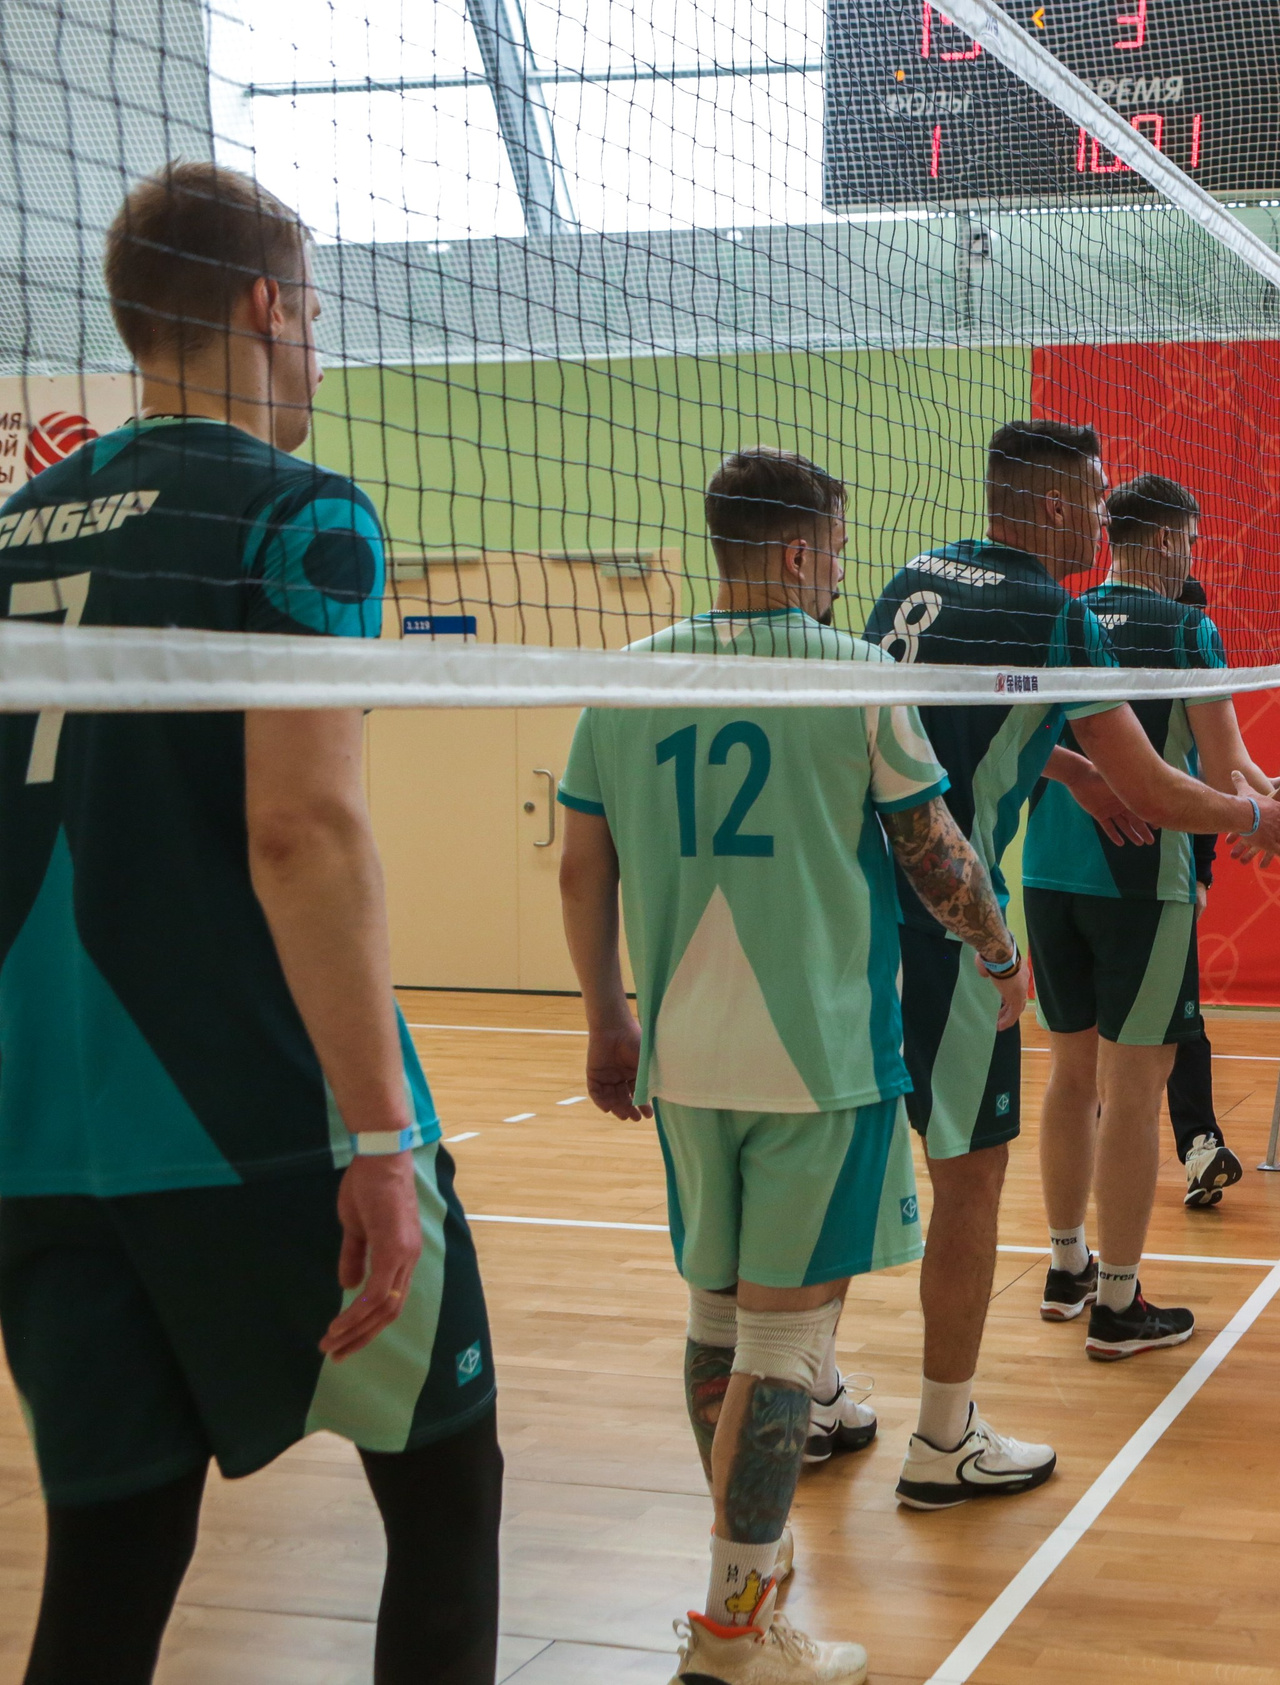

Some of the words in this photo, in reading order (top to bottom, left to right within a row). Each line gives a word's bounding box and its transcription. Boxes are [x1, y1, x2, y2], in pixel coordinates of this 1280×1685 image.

[930, 125, 942, 178] 1
[8, 570, 92, 785] 7
[879, 589, 943, 664] 8
[655, 720, 775, 858] 12
